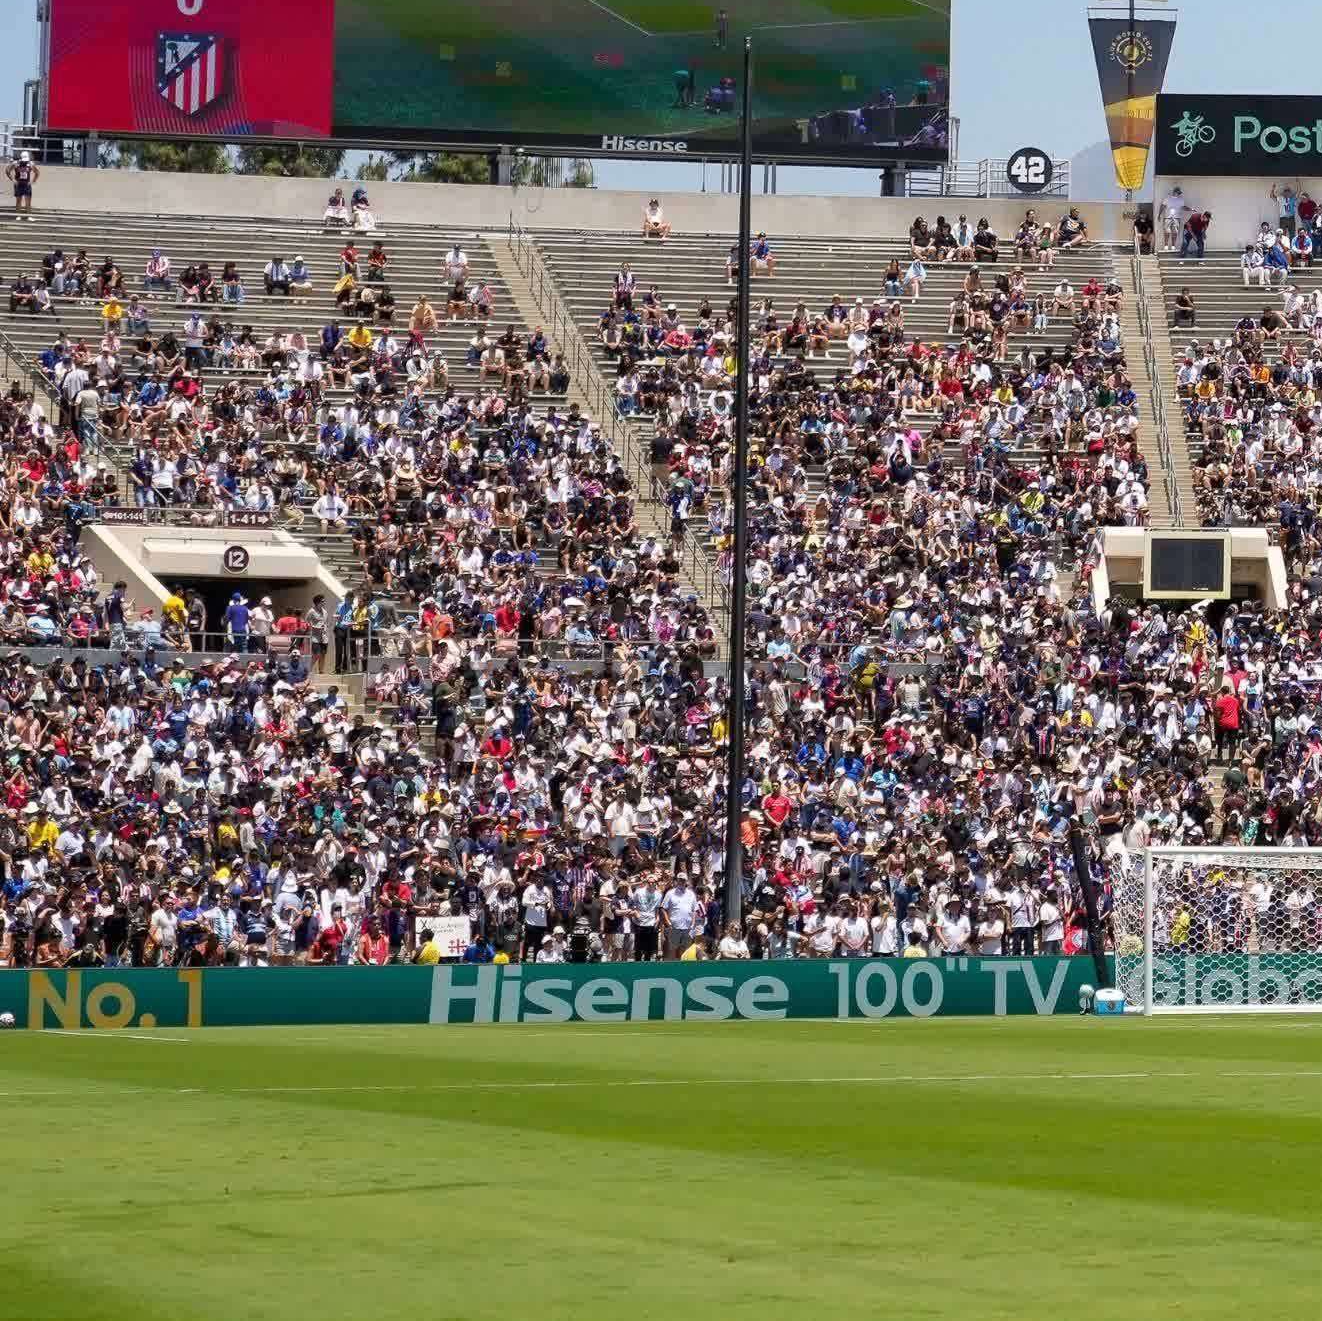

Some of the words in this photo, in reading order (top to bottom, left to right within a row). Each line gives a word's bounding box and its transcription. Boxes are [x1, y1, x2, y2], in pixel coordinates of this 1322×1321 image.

[601, 135, 689, 154] Hisense
[1010, 156, 1046, 184] 42
[113, 511, 143, 520] 101-141
[230, 514, 257, 524] 1-41
[228, 551, 244, 568] 12
[27, 969, 157, 1031] No.
[179, 968, 202, 1028] 1
[428, 964, 790, 1025] Hisense
